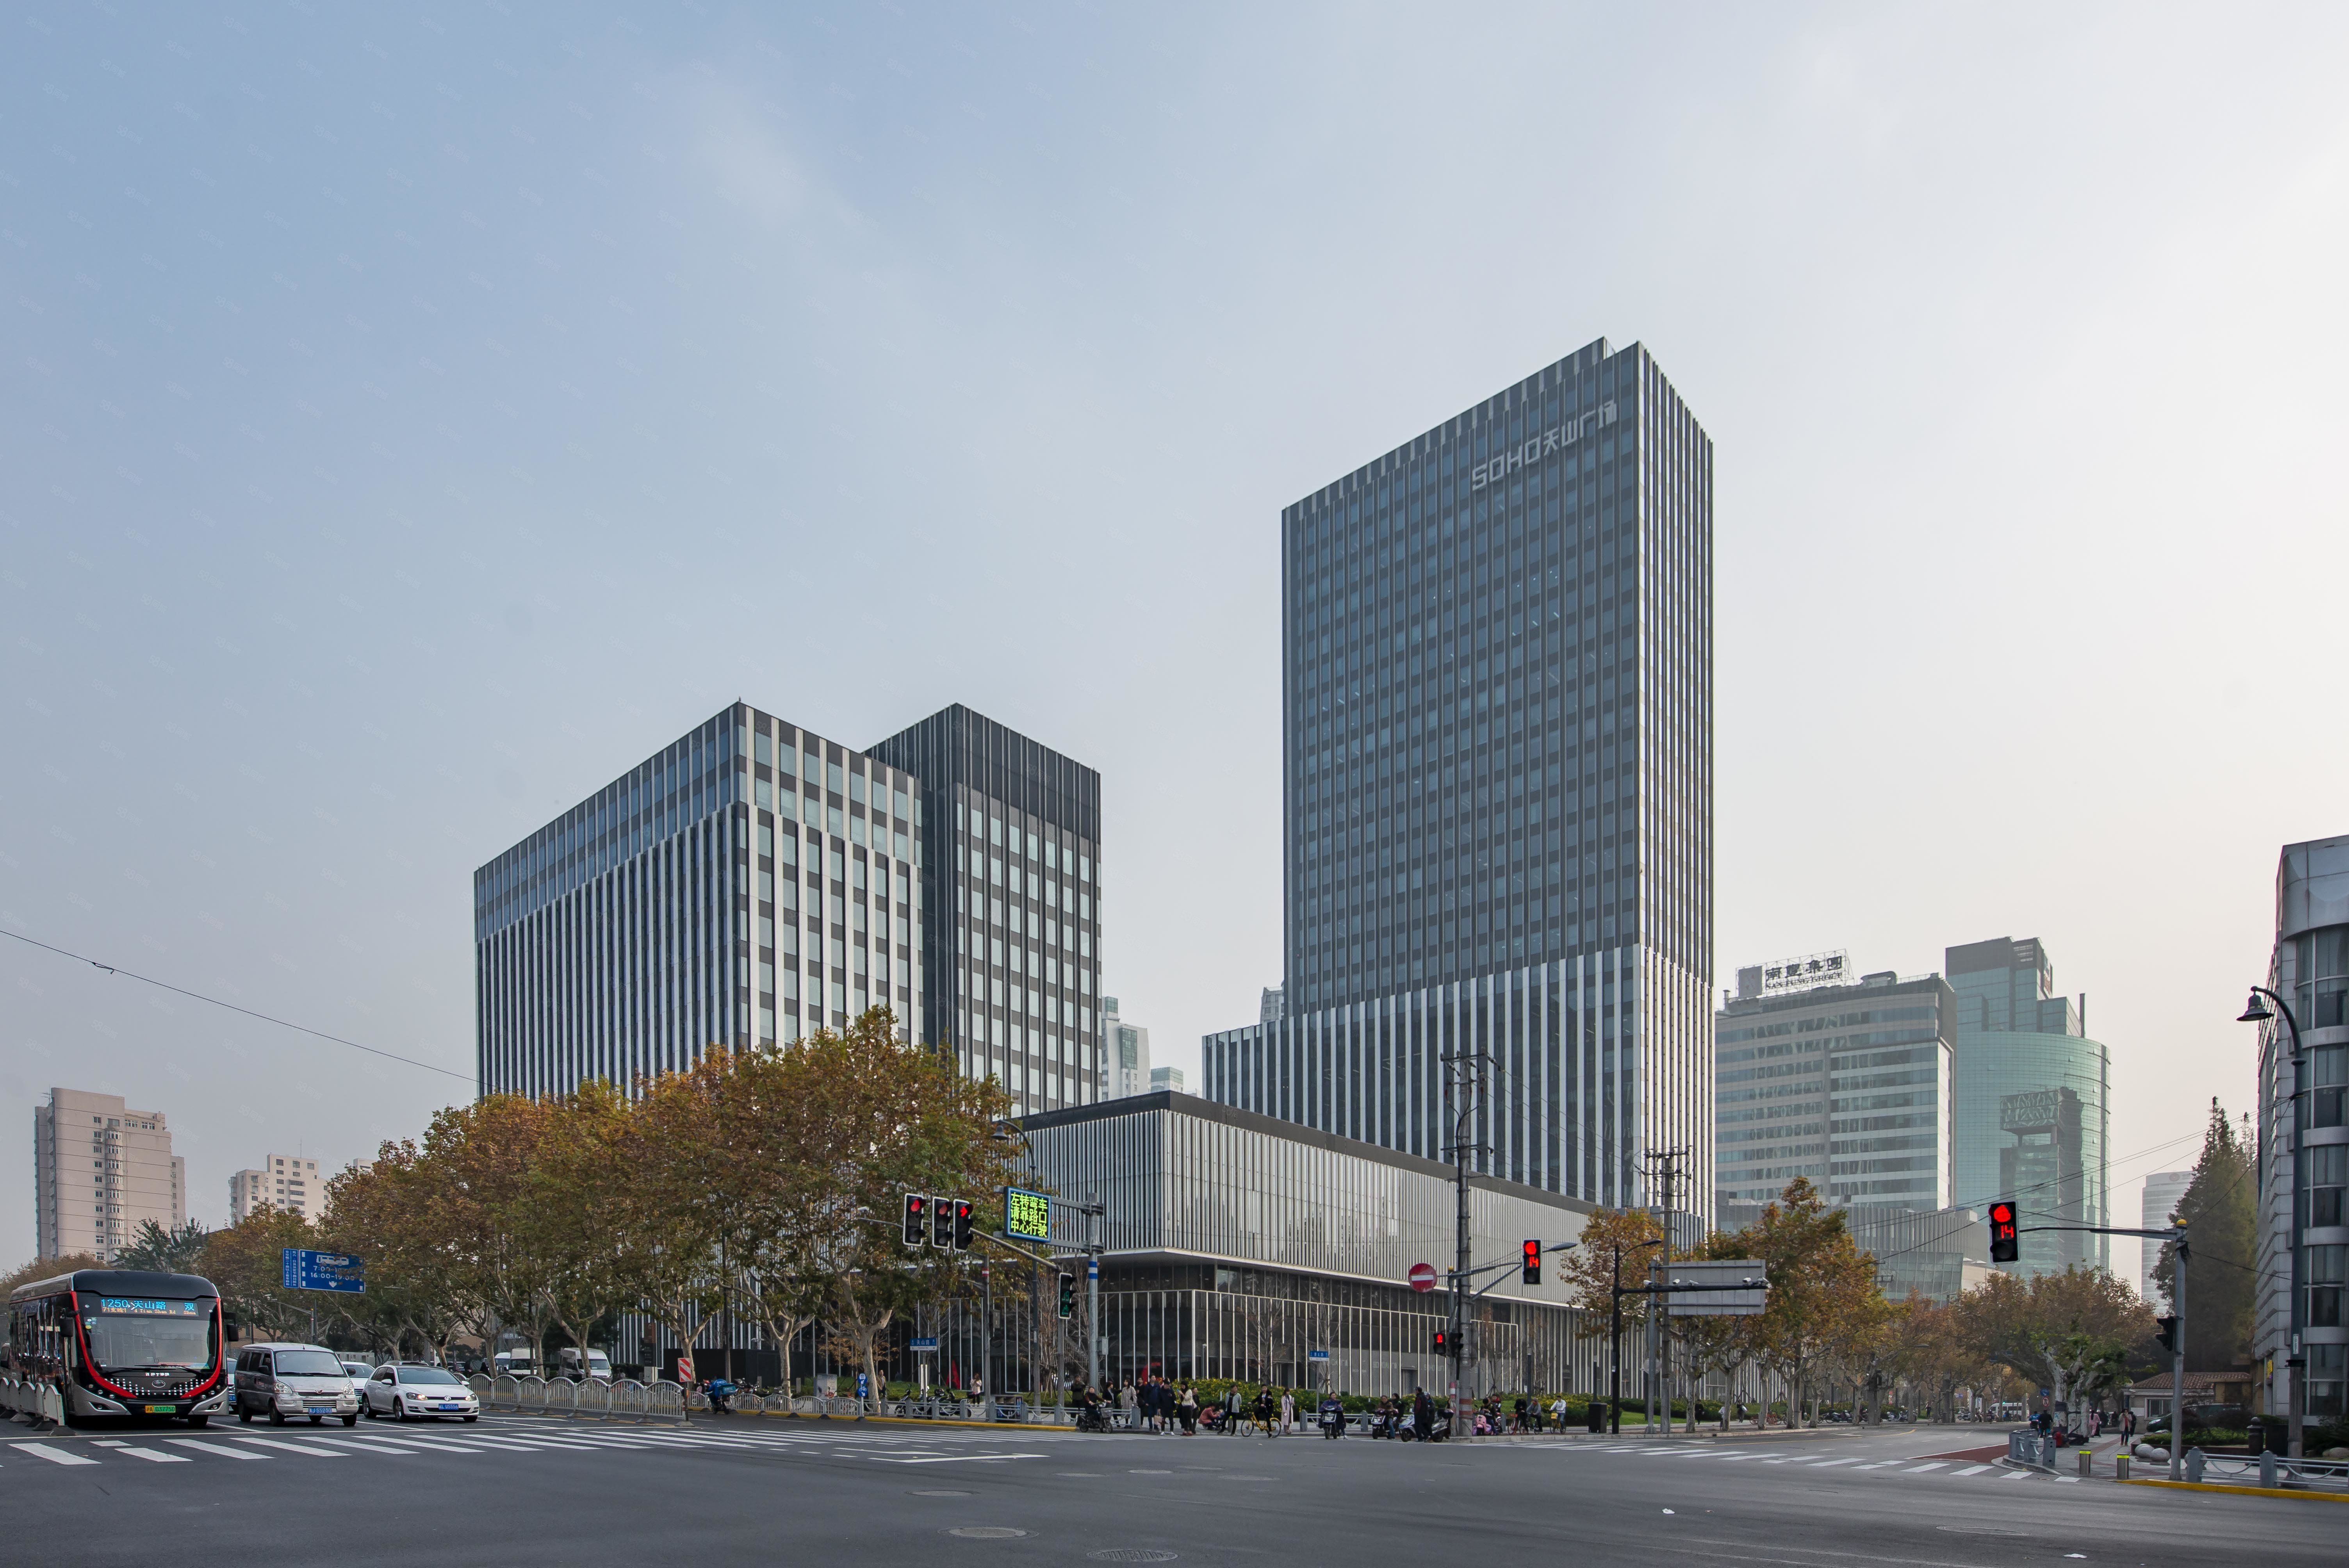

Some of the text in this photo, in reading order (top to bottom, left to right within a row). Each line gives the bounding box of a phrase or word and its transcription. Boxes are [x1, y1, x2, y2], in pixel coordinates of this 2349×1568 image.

[1472, 399, 1617, 491] SOHO天山广场
[1011, 1192, 1048, 1211] 左转弯车
[1011, 1205, 1047, 1224] 请靠路口
[1011, 1219, 1047, 1238] 中心行驶
[2000, 1225, 2014, 1238] 14
[1529, 1256, 1538, 1267] 14
[134, 1301, 166, 1310] 天山路
